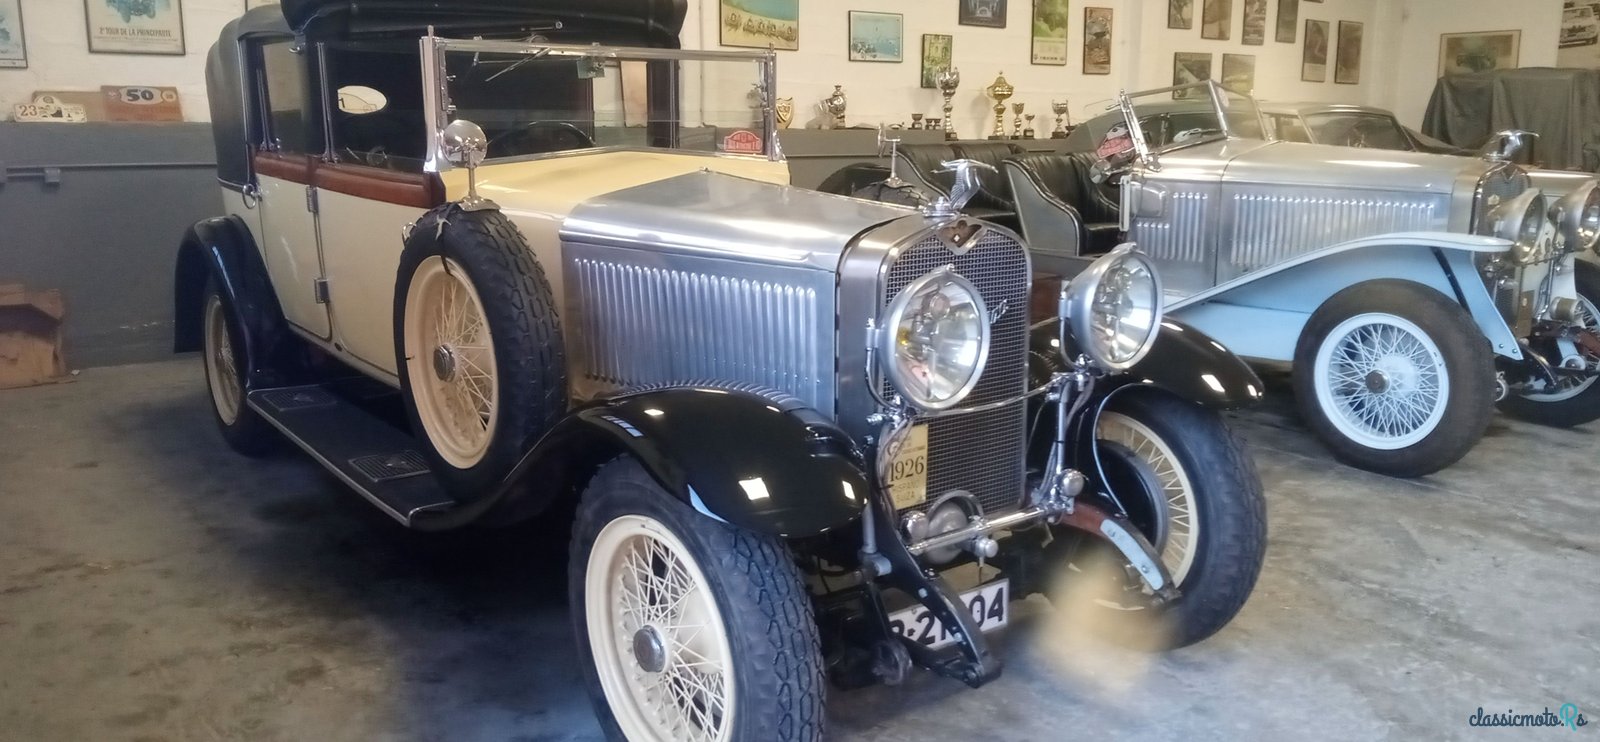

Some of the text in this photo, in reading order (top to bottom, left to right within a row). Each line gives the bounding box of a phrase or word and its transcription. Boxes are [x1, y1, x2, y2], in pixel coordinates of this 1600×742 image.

[106, 27, 119, 35] TOUR
[120, 27, 127, 35] DE
[128, 28, 136, 36] LA
[126, 88, 154, 102] 50
[19, 104, 38, 117] 23
[890, 455, 925, 482] 1926
